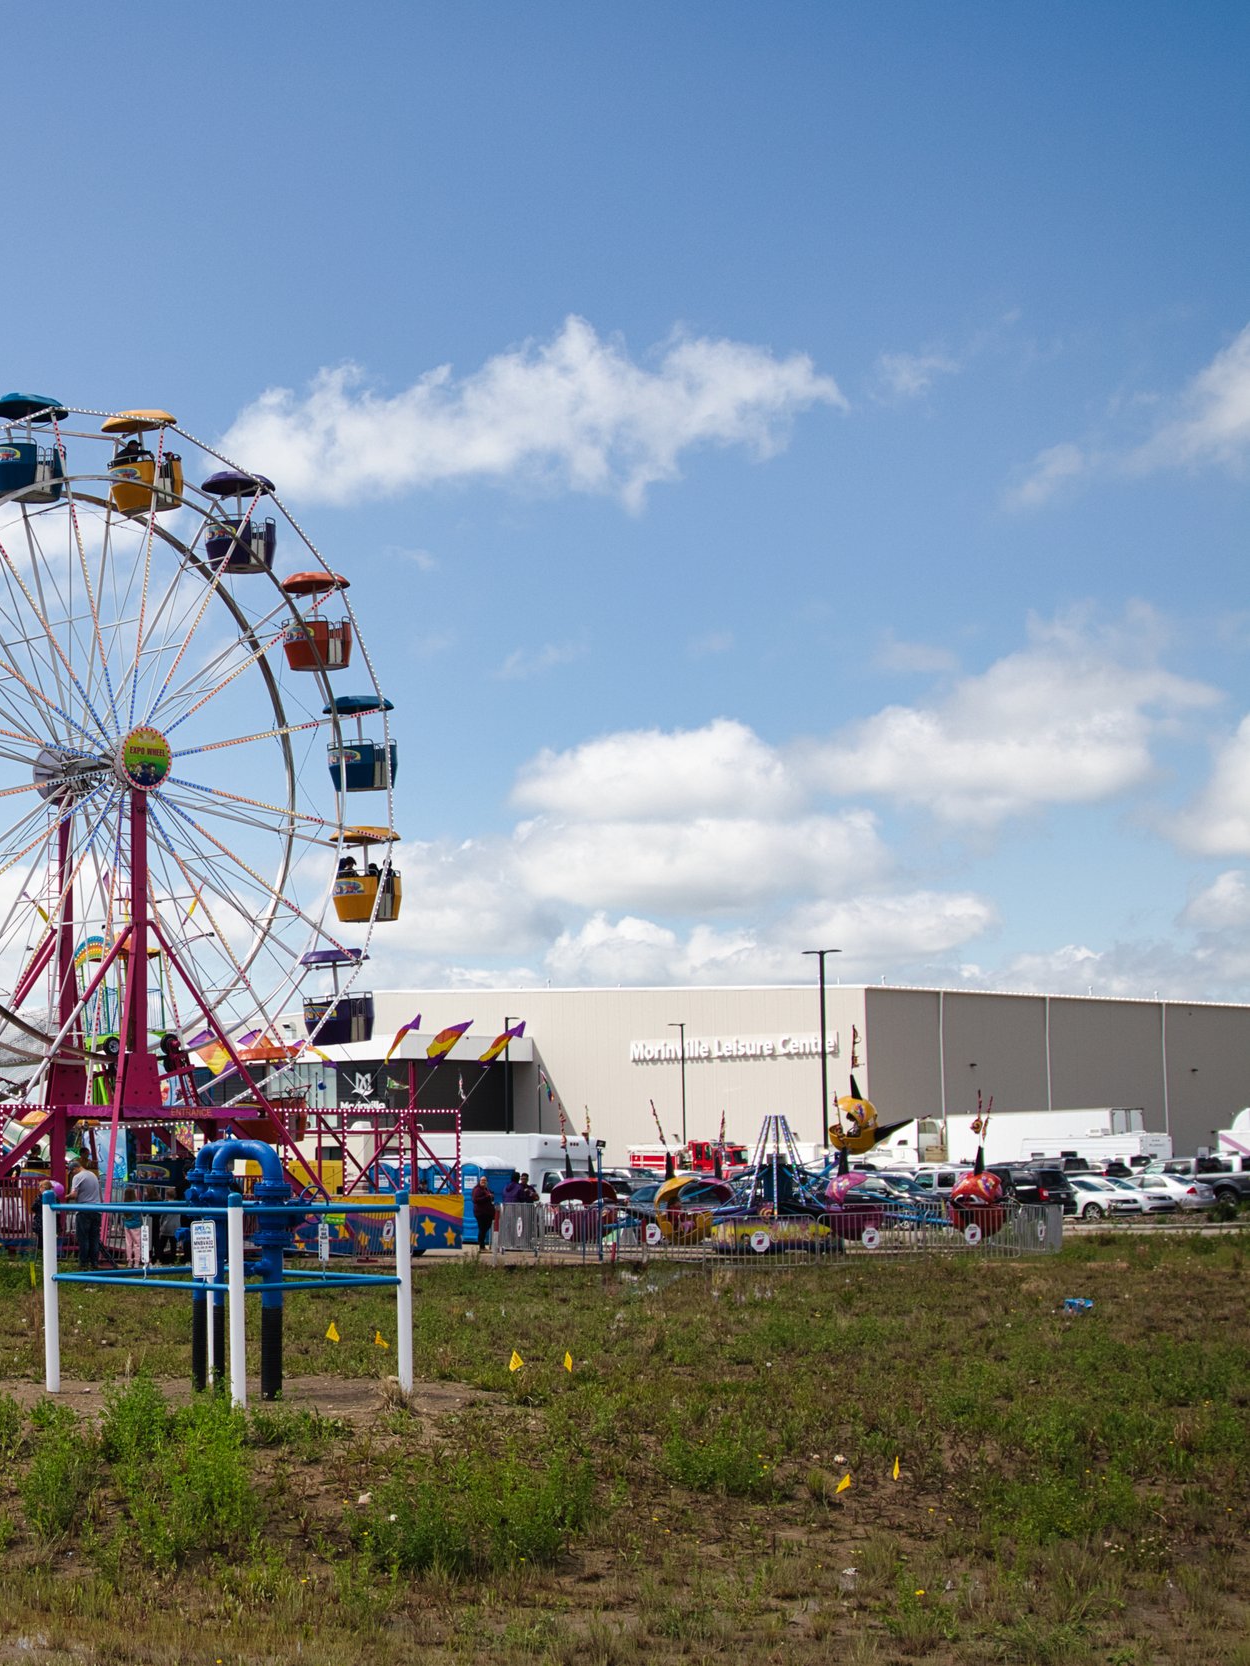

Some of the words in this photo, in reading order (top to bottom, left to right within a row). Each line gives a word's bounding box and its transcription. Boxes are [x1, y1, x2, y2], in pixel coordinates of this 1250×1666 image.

[129, 746, 146, 755] EXPO
[147, 747, 166, 757] WHEEL
[630, 1040, 710, 1062] Morinville
[714, 1037, 774, 1057] Leisure
[170, 1108, 212, 1117] ENTRANCE
